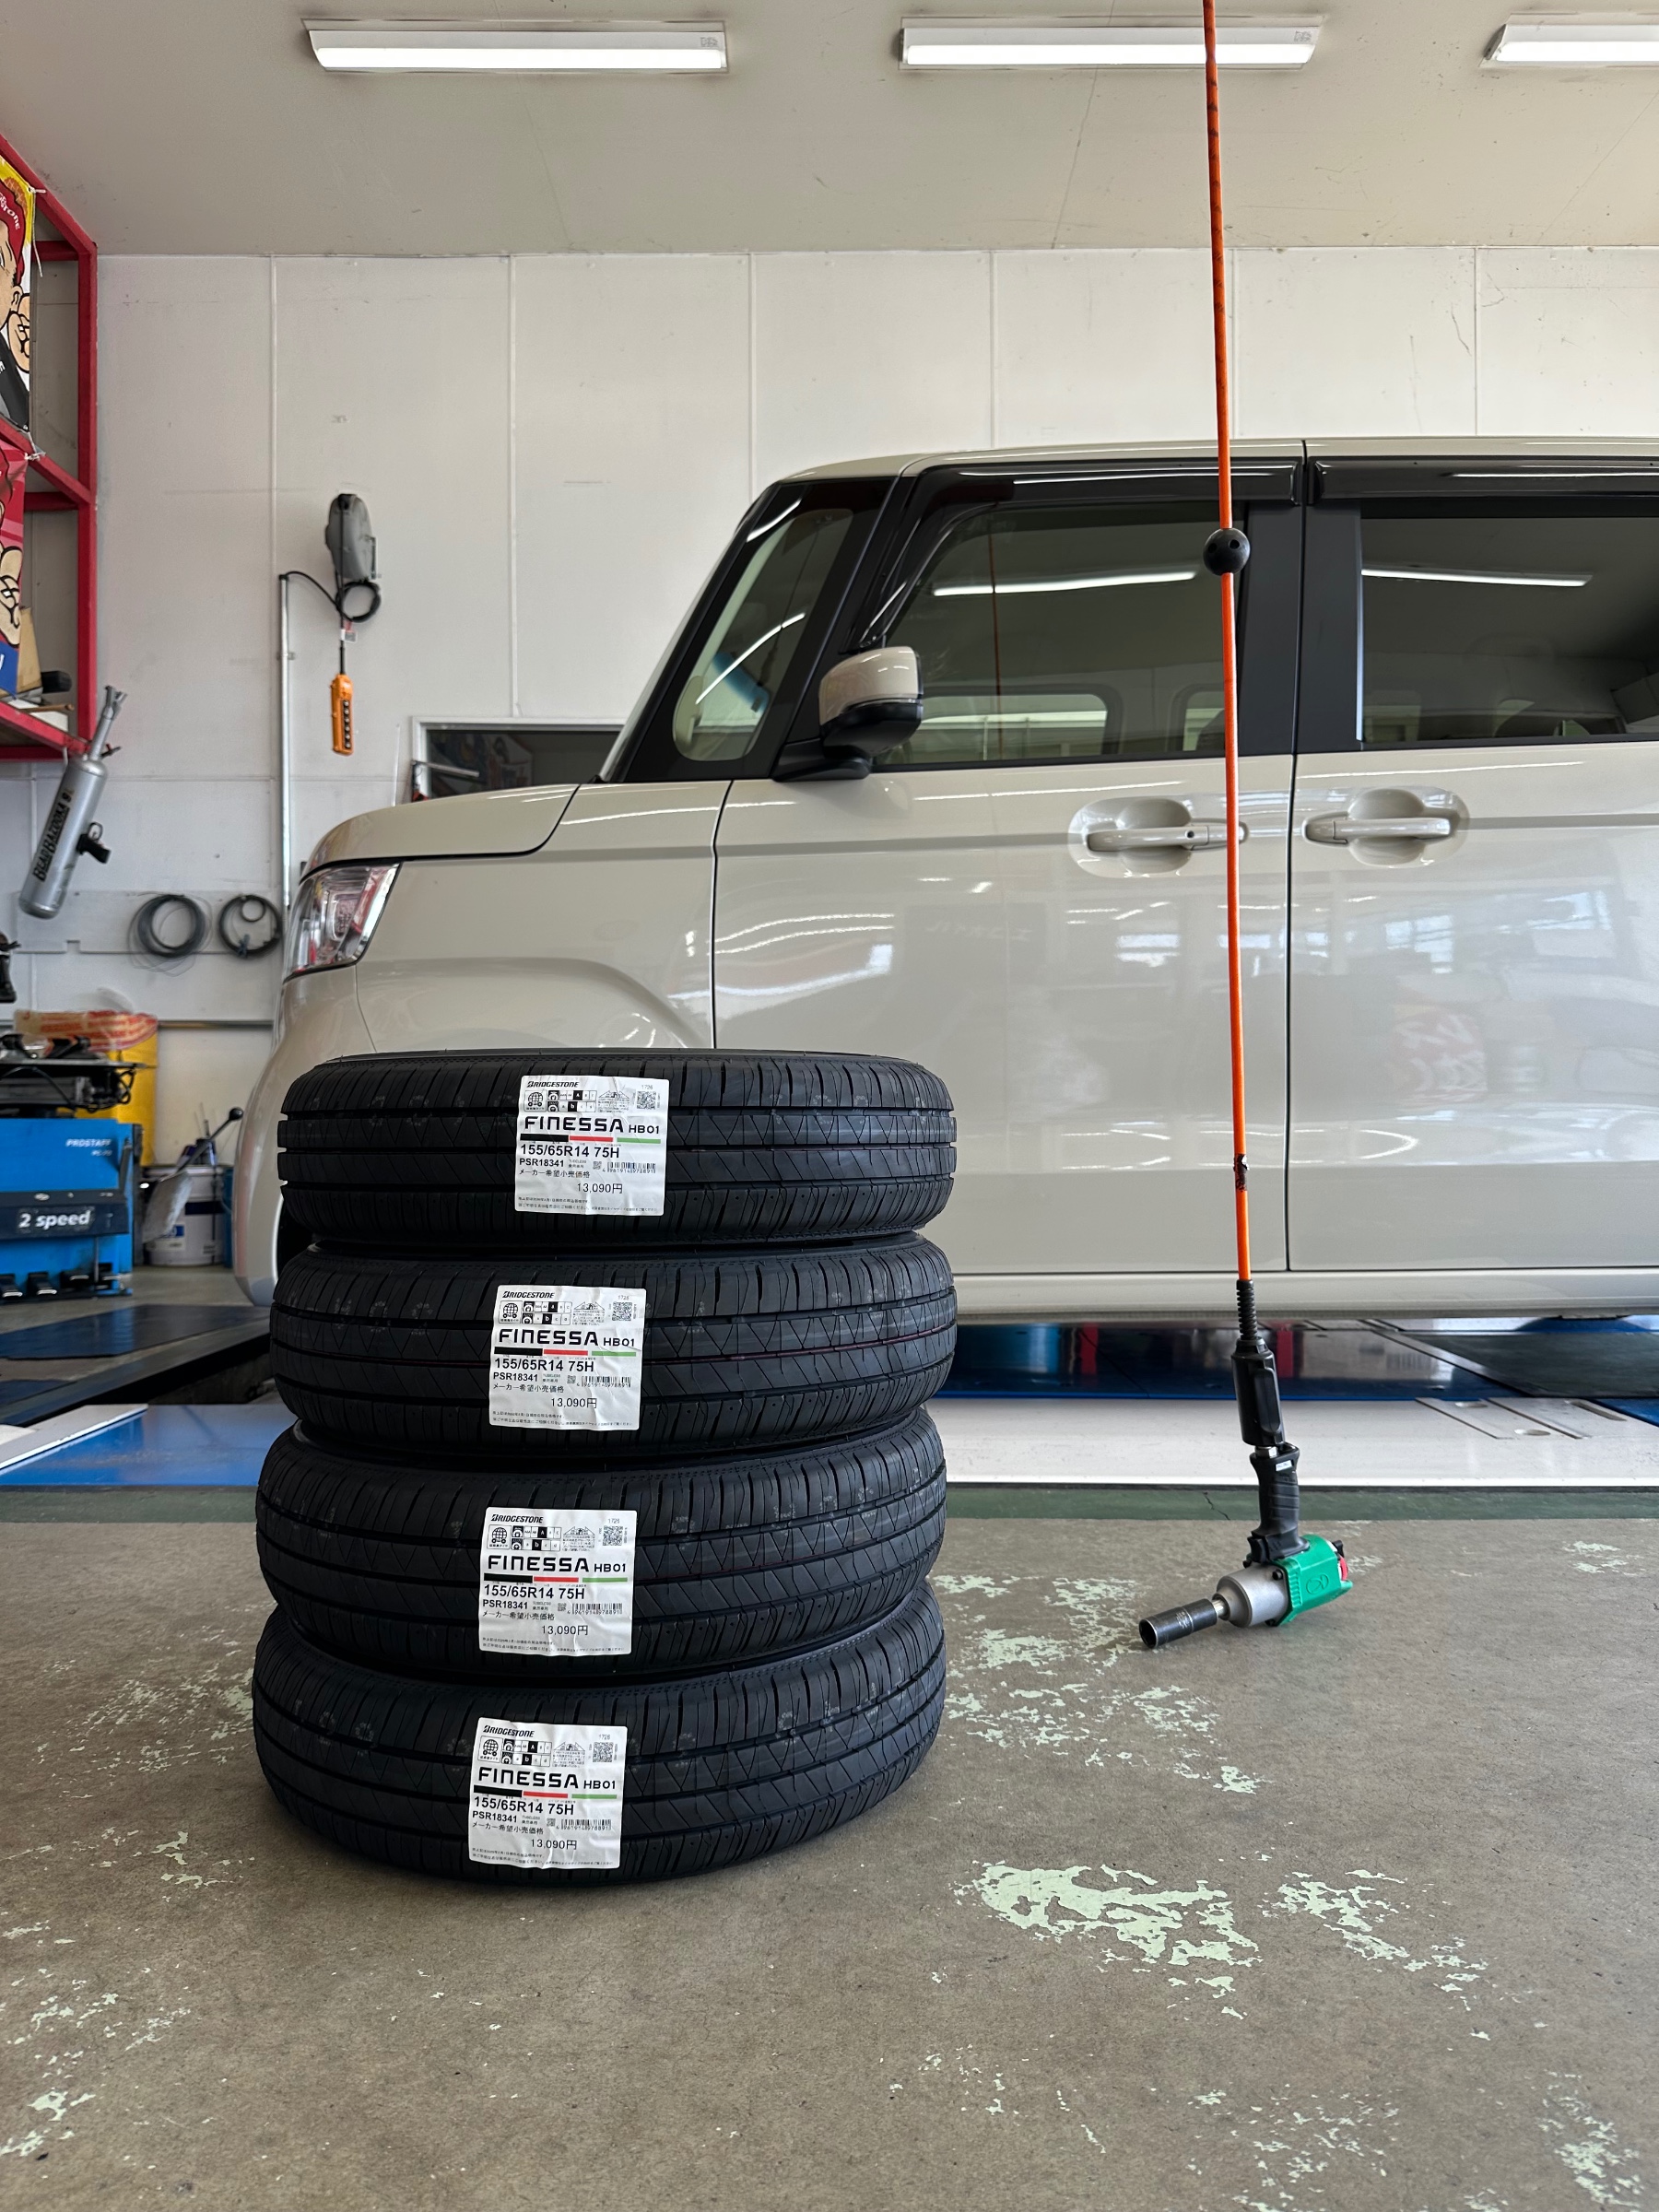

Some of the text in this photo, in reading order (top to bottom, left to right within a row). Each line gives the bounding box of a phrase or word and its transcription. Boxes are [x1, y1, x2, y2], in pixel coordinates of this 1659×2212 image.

[526, 1080, 580, 1088] BRIDGESTONE
[524, 1116, 660, 1134] FINESSA HB01
[65, 1138, 112, 1147] PROSTAFF
[520, 1144, 590, 1158] 155/65R14
[594, 1147, 619, 1159] 75H
[519, 1159, 564, 1168] PSR18341
[519, 1169, 591, 1179] メーカー希望小売価格
[577, 1182, 623, 1194] 13,090円
[18, 1209, 91, 1230] 2 speed
[502, 1290, 555, 1299] BRIDGESTONE
[499, 1328, 635, 1347] FINESSA HB01
[494, 1359, 594, 1372] 155/65R14 75H
[493, 1372, 538, 1382] PSR18341
[493, 1383, 564, 1394] メーカー希望小売価格
[550, 1397, 597, 1409] 13,090円
[491, 1513, 544, 1524] BRIDGESTONE
[488, 1555, 627, 1572] FINESSA HB01
[484, 1584, 585, 1600] 155/65R14 75H
[482, 1599, 528, 1610] PSR18341
[482, 1611, 555, 1621] メーカー希望小売価格
[541, 1625, 588, 1636] 13,090円
[483, 1724, 535, 1737] BRIDGESTONE
[478, 1766, 616, 1790] FINESSA HB01
[474, 1796, 544, 1814] 155/65R14
[548, 1803, 574, 1816] 75H
[472, 1810, 518, 1823] PSR18341
[472, 1821, 544, 1835] メーカー希望小売価格
[531, 1839, 578, 1851] 13,090円
